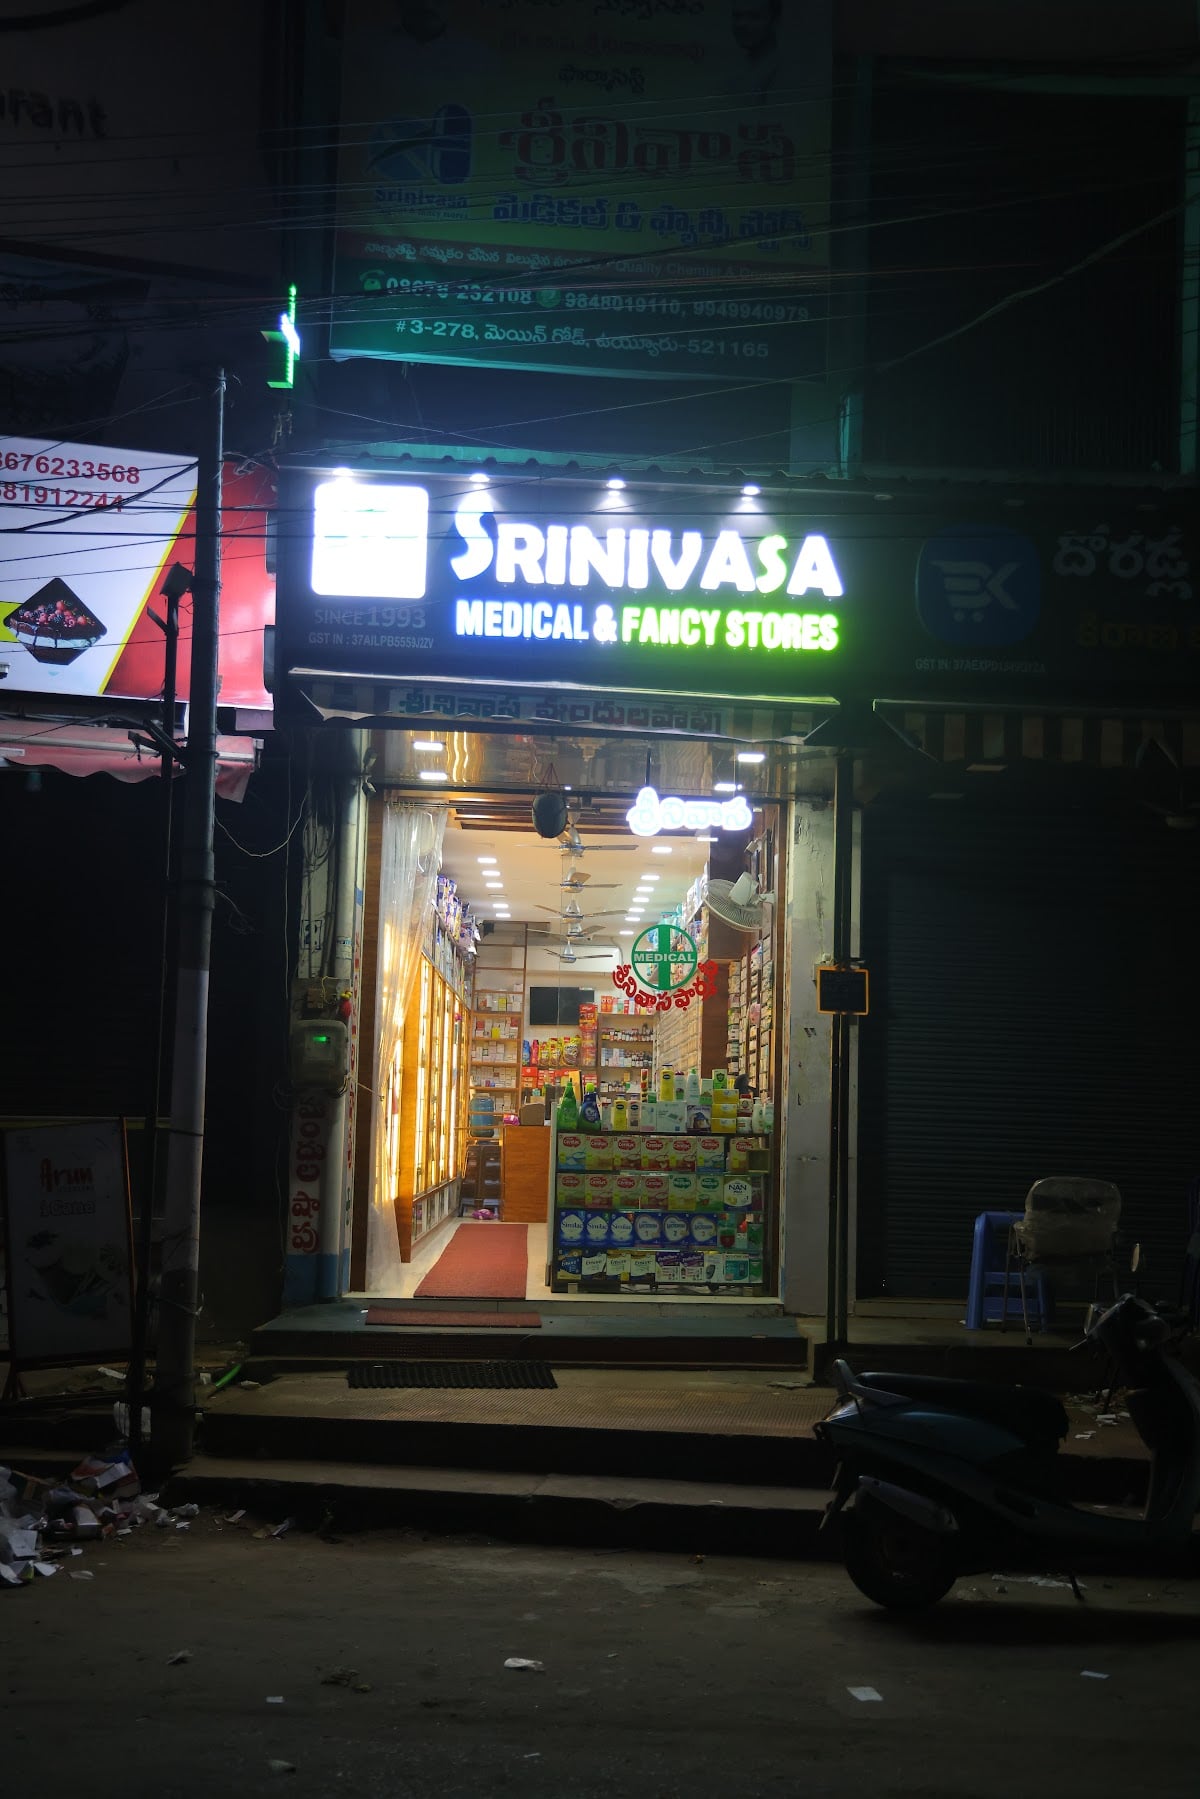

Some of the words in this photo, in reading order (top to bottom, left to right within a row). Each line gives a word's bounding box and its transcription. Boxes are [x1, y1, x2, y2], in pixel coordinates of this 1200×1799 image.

[0, 88, 108, 139] rant
[615, 260, 662, 277] Quality
[0, 450, 140, 484] 676233568
[0, 482, 123, 513] 81912244
[313, 608, 363, 626] SINCE
[367, 606, 426, 629] 1993
[456, 600, 588, 641] MEDICAL
[593, 605, 618, 643] &
[622, 606, 721, 647] FANCY
[725, 610, 840, 651] STORES
[308, 632, 331, 644] GST
[333, 632, 343, 644] IN
[633, 952, 695, 962] MEDICAL
